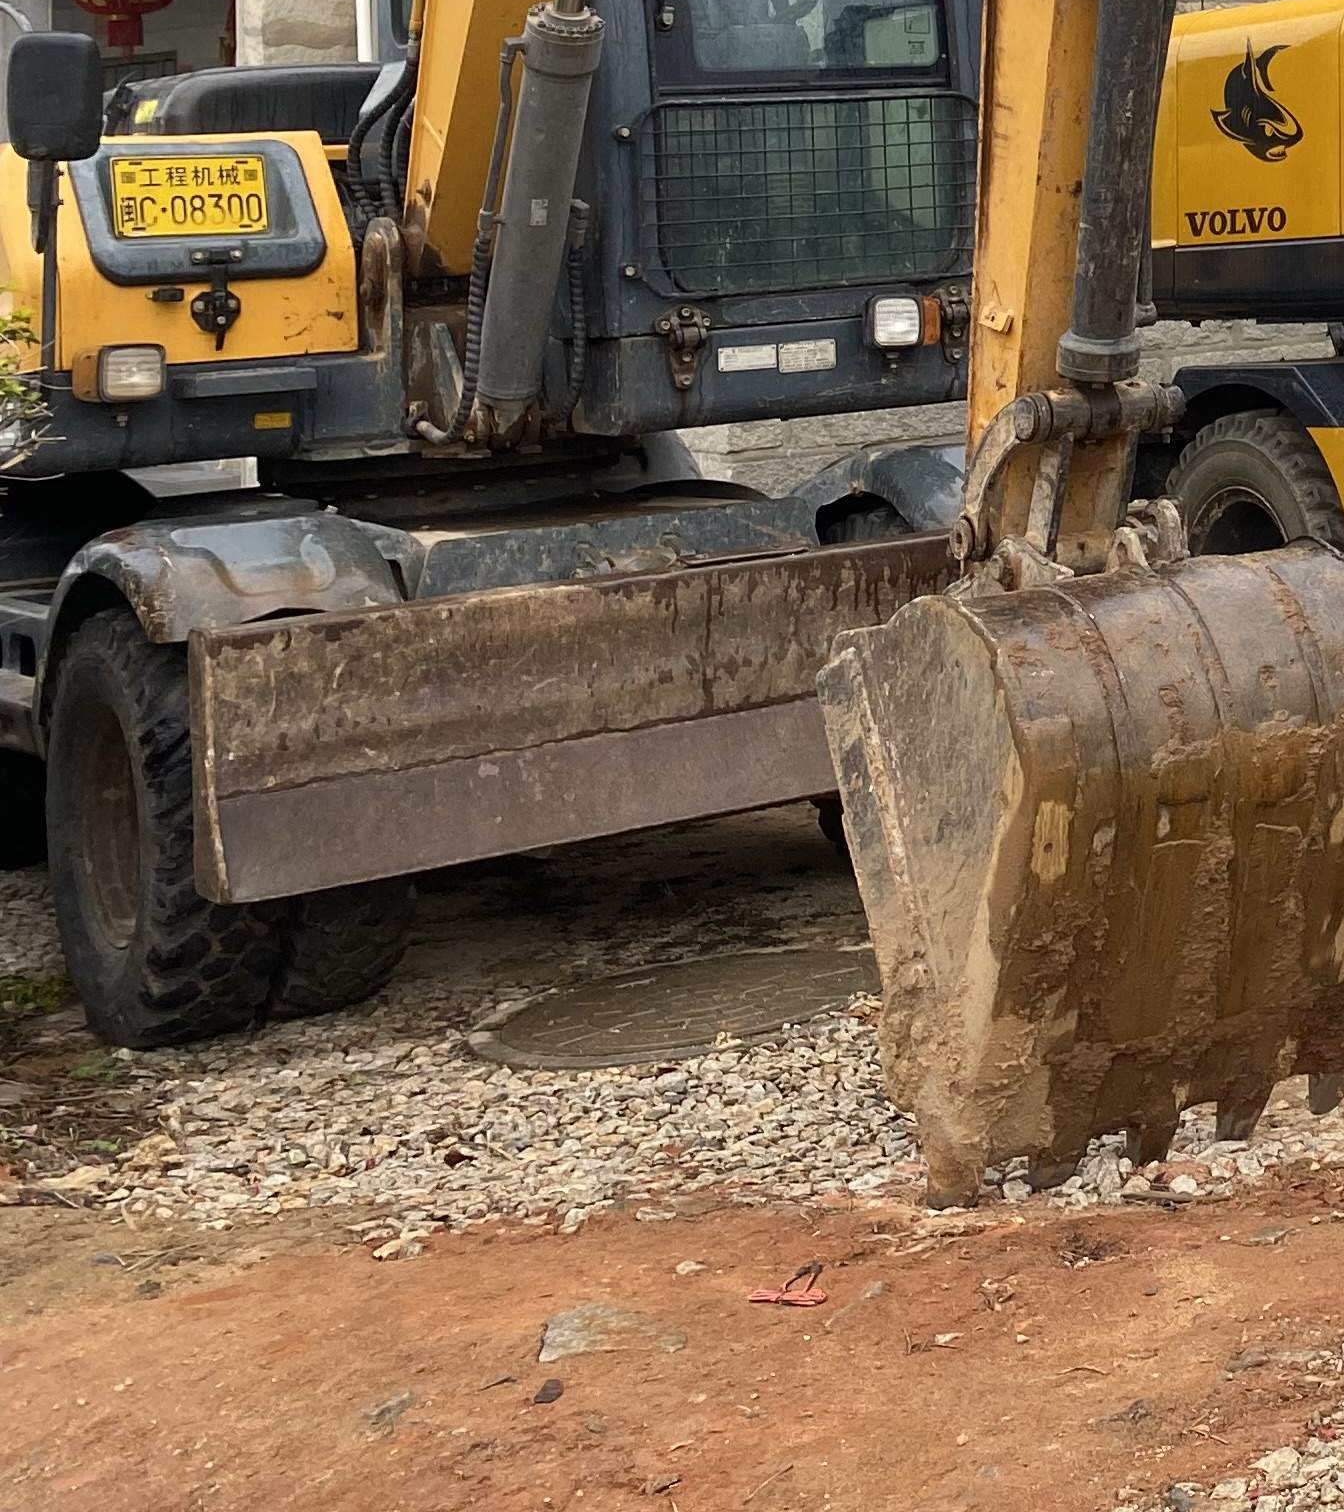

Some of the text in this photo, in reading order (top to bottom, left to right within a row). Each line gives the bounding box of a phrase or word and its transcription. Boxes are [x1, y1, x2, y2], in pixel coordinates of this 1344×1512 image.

[139, 165, 241, 187] 工程机械
[1185, 206, 1286, 236] VOLVO
